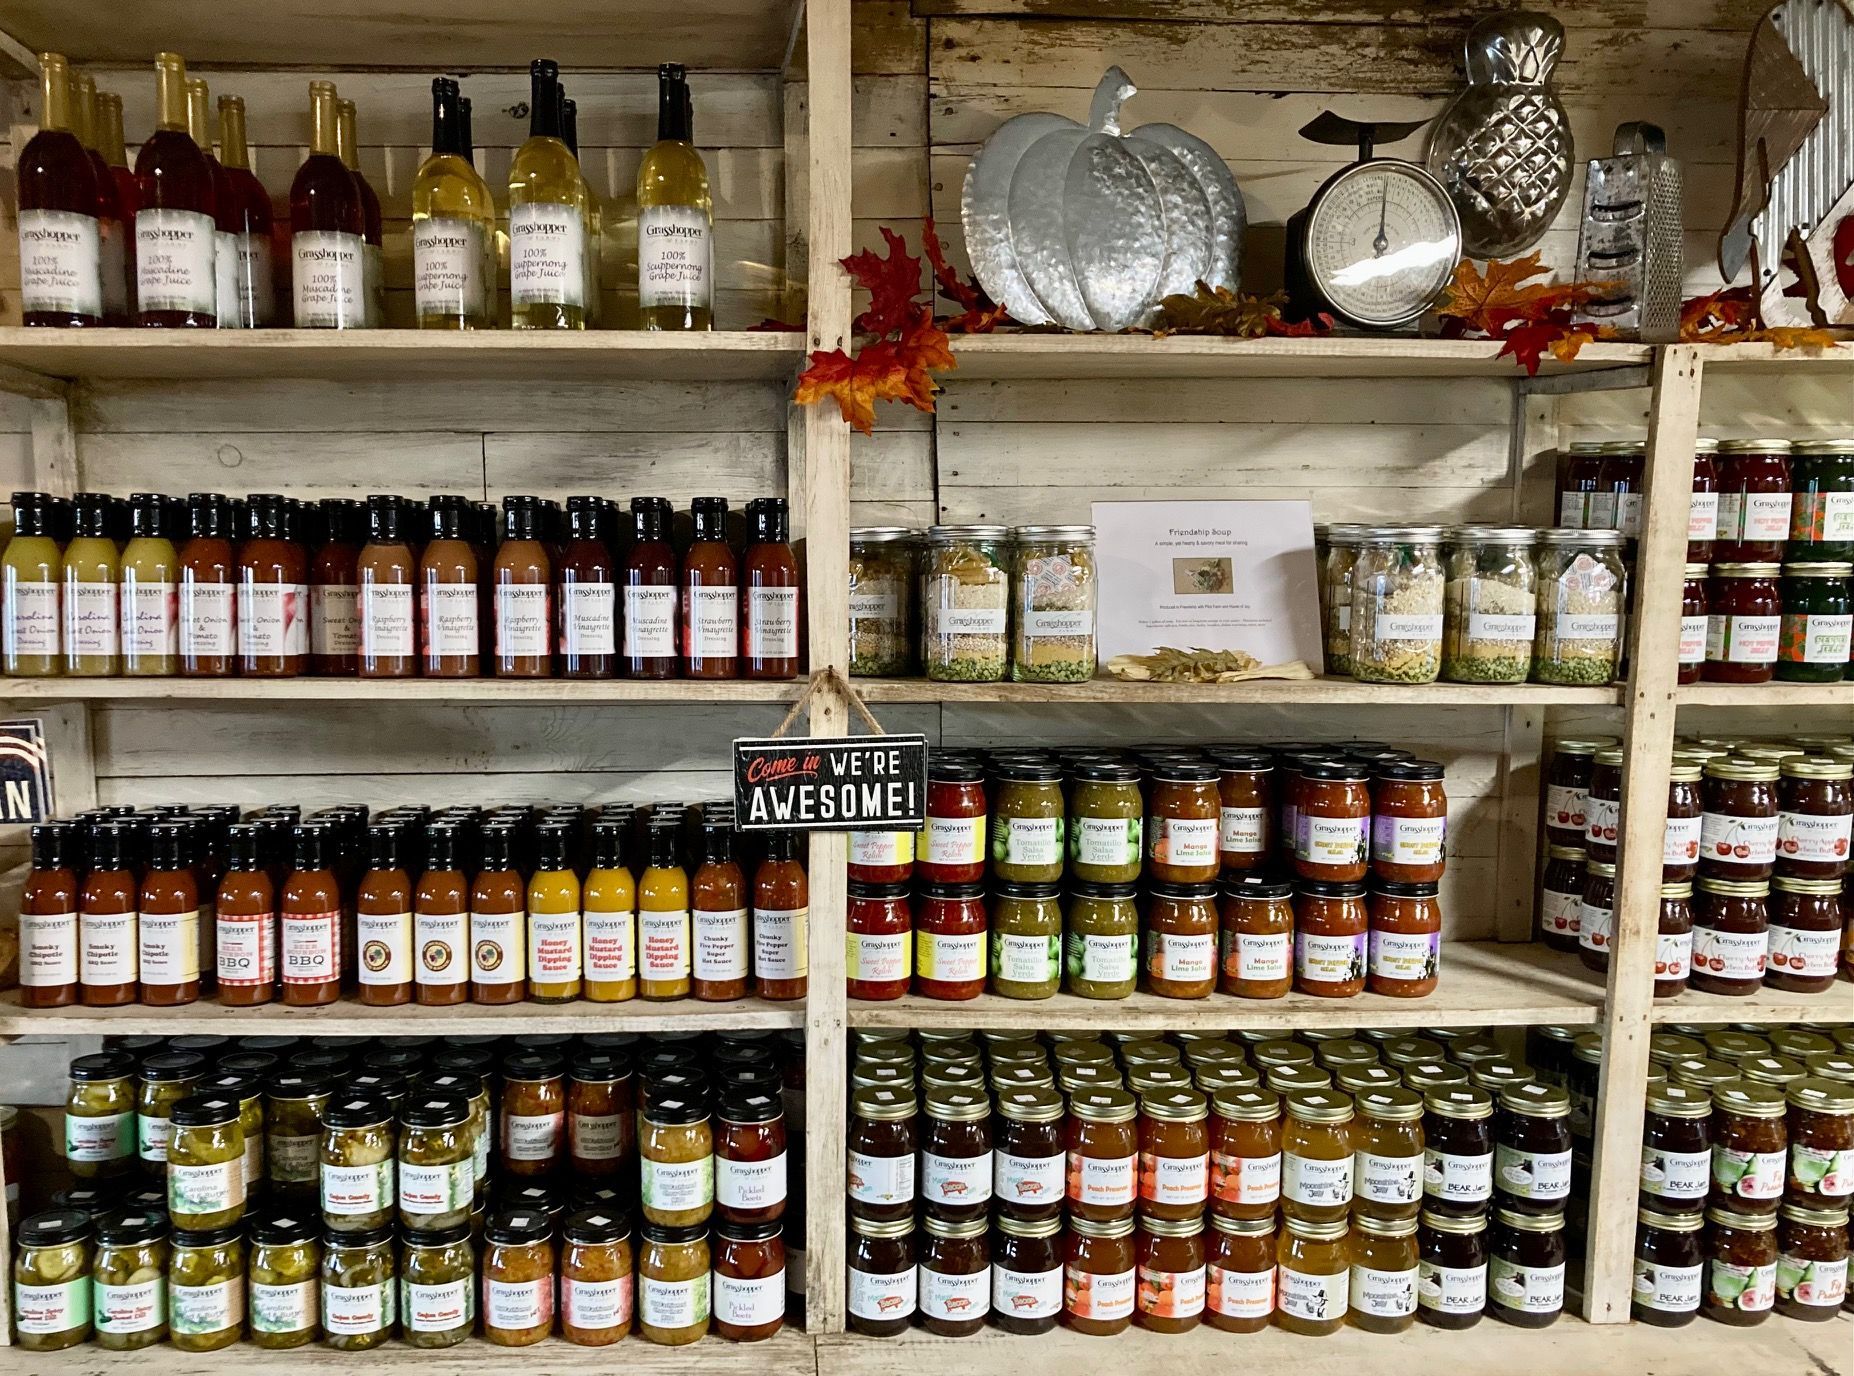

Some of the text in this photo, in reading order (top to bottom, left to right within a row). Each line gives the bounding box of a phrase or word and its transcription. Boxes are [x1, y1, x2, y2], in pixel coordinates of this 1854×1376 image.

[513, 222, 567, 234] Grasshopper
[647, 224, 702, 237] Grasshopper
[416, 235, 467, 248] Grasshopper
[524, 249, 547, 257] 100%
[662, 251, 685, 260] 100%
[33, 256, 58, 264] 100%
[148, 256, 172, 264] 100%
[426, 261, 447, 270] 100%
[514, 260, 566, 270] Scuppernong
[647, 262, 702, 273] Scuppernong
[312, 275, 336, 283] 100%
[417, 271, 468, 282] Scuppernong
[515, 269, 536, 280] Grape
[649, 271, 701, 282] Grape Juice
[164, 277, 191, 286] Juice
[303, 284, 352, 294] Muscadne
[418, 281, 437, 292] Grape
[302, 294, 352, 304] Grape Juce
[1212, 528, 1231, 536] Soup
[433, 589, 475, 598] Grasshopper
[500, 589, 542, 599] Grasshopper
[569, 588, 611, 598] Grasshopper
[694, 591, 736, 600] Grasshopper
[752, 591, 794, 600] Grasshopper
[372, 615, 406, 624] Raspberry
[439, 615, 472, 625] Raspberry
[505, 616, 539, 625] Raspberry
[632, 617, 667, 625] Muscadine
[697, 618, 733, 627] Strawberry
[755, 619, 791, 627] Strawberry
[949, 617, 994, 626] Grasshopper
[1036, 619, 1082, 629] Grasshopper
[437, 624, 474, 633] Vinaigrette
[503, 625, 541, 633] Vinaigrette
[574, 623, 610, 632] Vinaigrette
[698, 626, 733, 636] Vinaigrette
[755, 627, 791, 636] Vinaigrette
[747, 751, 900, 783] Come in WE'RE
[0, 781, 32, 819] N
[750, 782, 915, 821] AWESOME!
[1223, 811, 1263, 821] Grasshopper
[931, 823, 972, 832] Grasshopper
[1013, 823, 1053, 832] Grasshopper
[1083, 823, 1124, 832] Grasshopper
[1173, 824, 1212, 833] Grasshopper
[1315, 824, 1357, 834] Grasshopper
[534, 921, 575, 930] Grasshopper
[592, 937, 617, 945] Honey
[648, 936, 674, 944] Honey
[538, 946, 572, 954] Mustard
[289, 955, 324, 965] BBQ
[538, 955, 572, 963] Dipping
[590, 953, 622, 961] Dipping
[646, 952, 678, 960] Dipping
[219, 957, 249, 968] BBQ
[729, 1302, 754, 1311] Pickled
